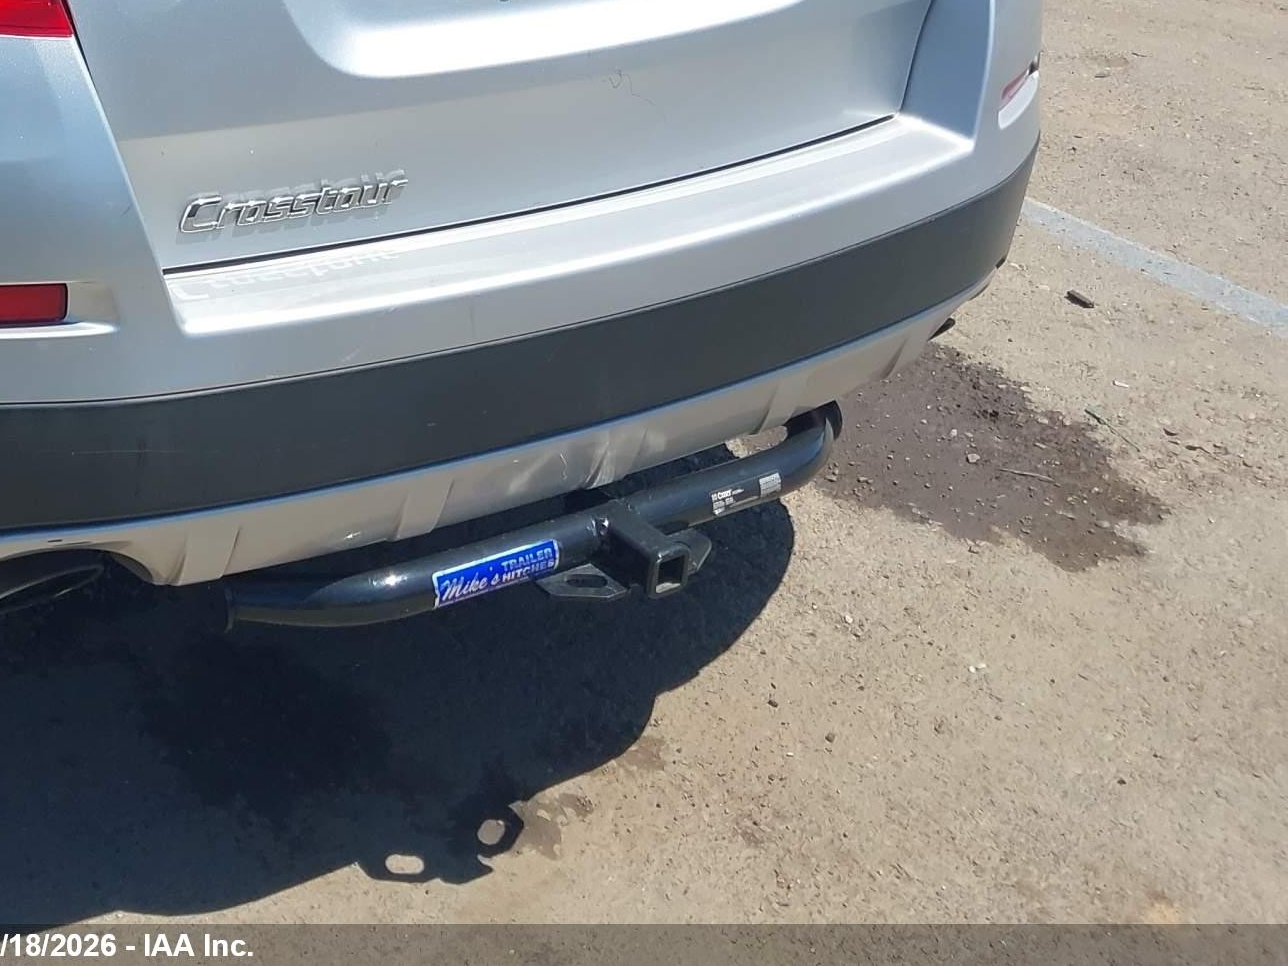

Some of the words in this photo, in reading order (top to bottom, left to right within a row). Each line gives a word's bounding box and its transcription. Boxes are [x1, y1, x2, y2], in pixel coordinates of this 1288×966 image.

[179, 177, 409, 234] Crosstour
[501, 547, 553, 571] TRAILER
[440, 566, 501, 602] Mike's
[502, 560, 555, 583] HITCHES
